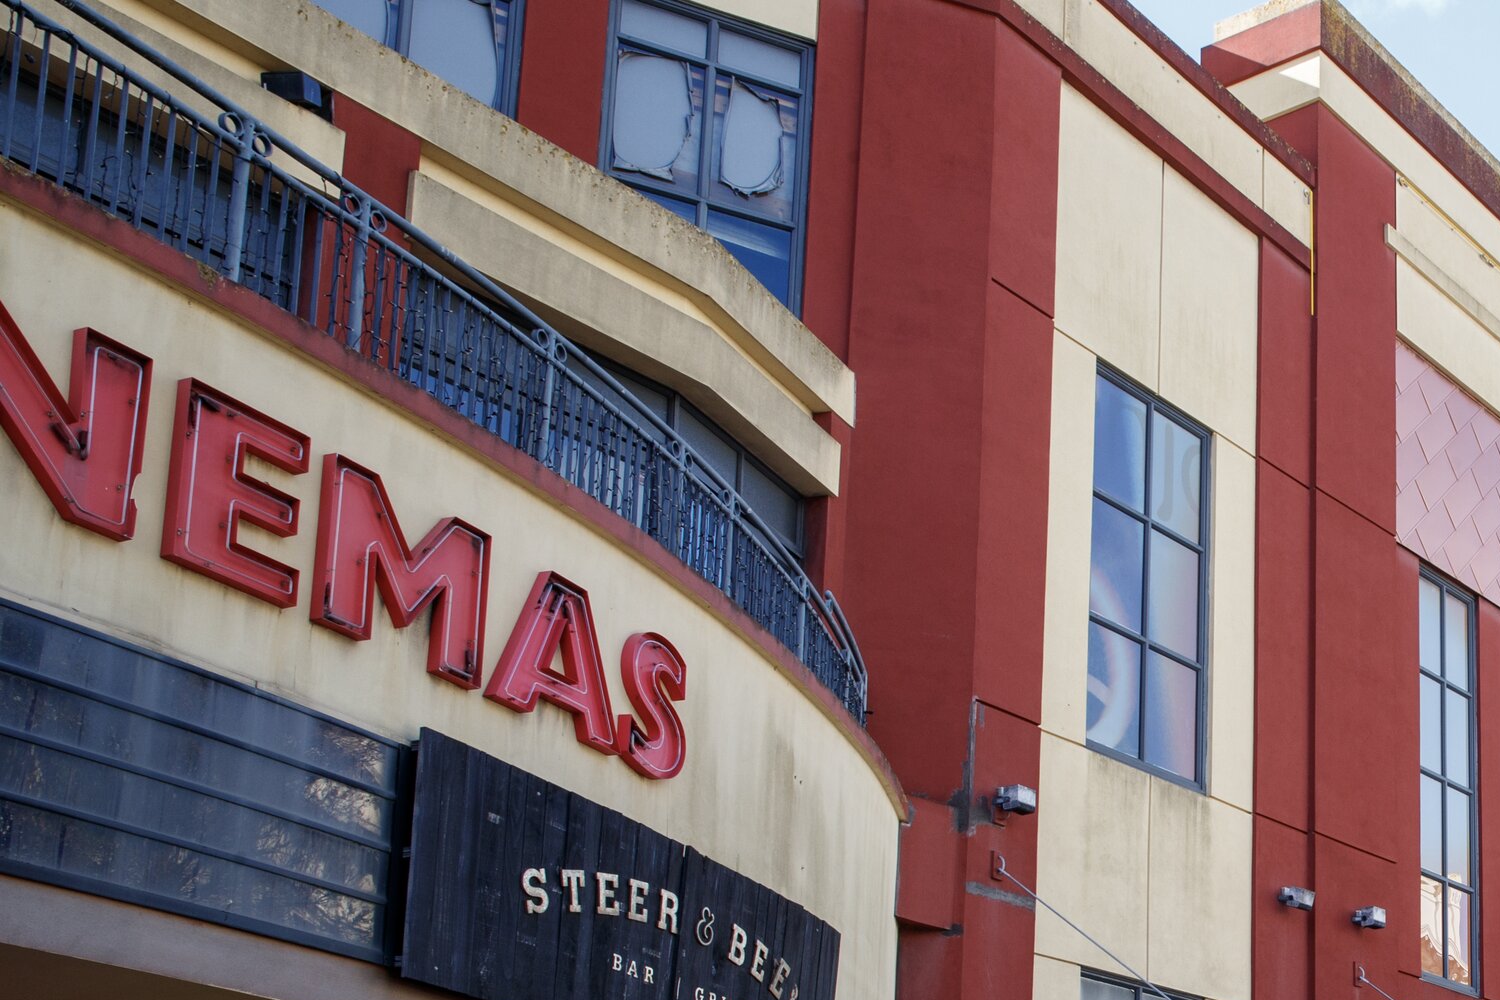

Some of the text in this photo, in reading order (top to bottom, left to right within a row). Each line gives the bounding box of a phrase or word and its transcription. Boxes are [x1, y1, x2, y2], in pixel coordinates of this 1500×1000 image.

[521, 868, 680, 936] STEER
[695, 906, 716, 947] &
[612, 952, 655, 985] BAR
